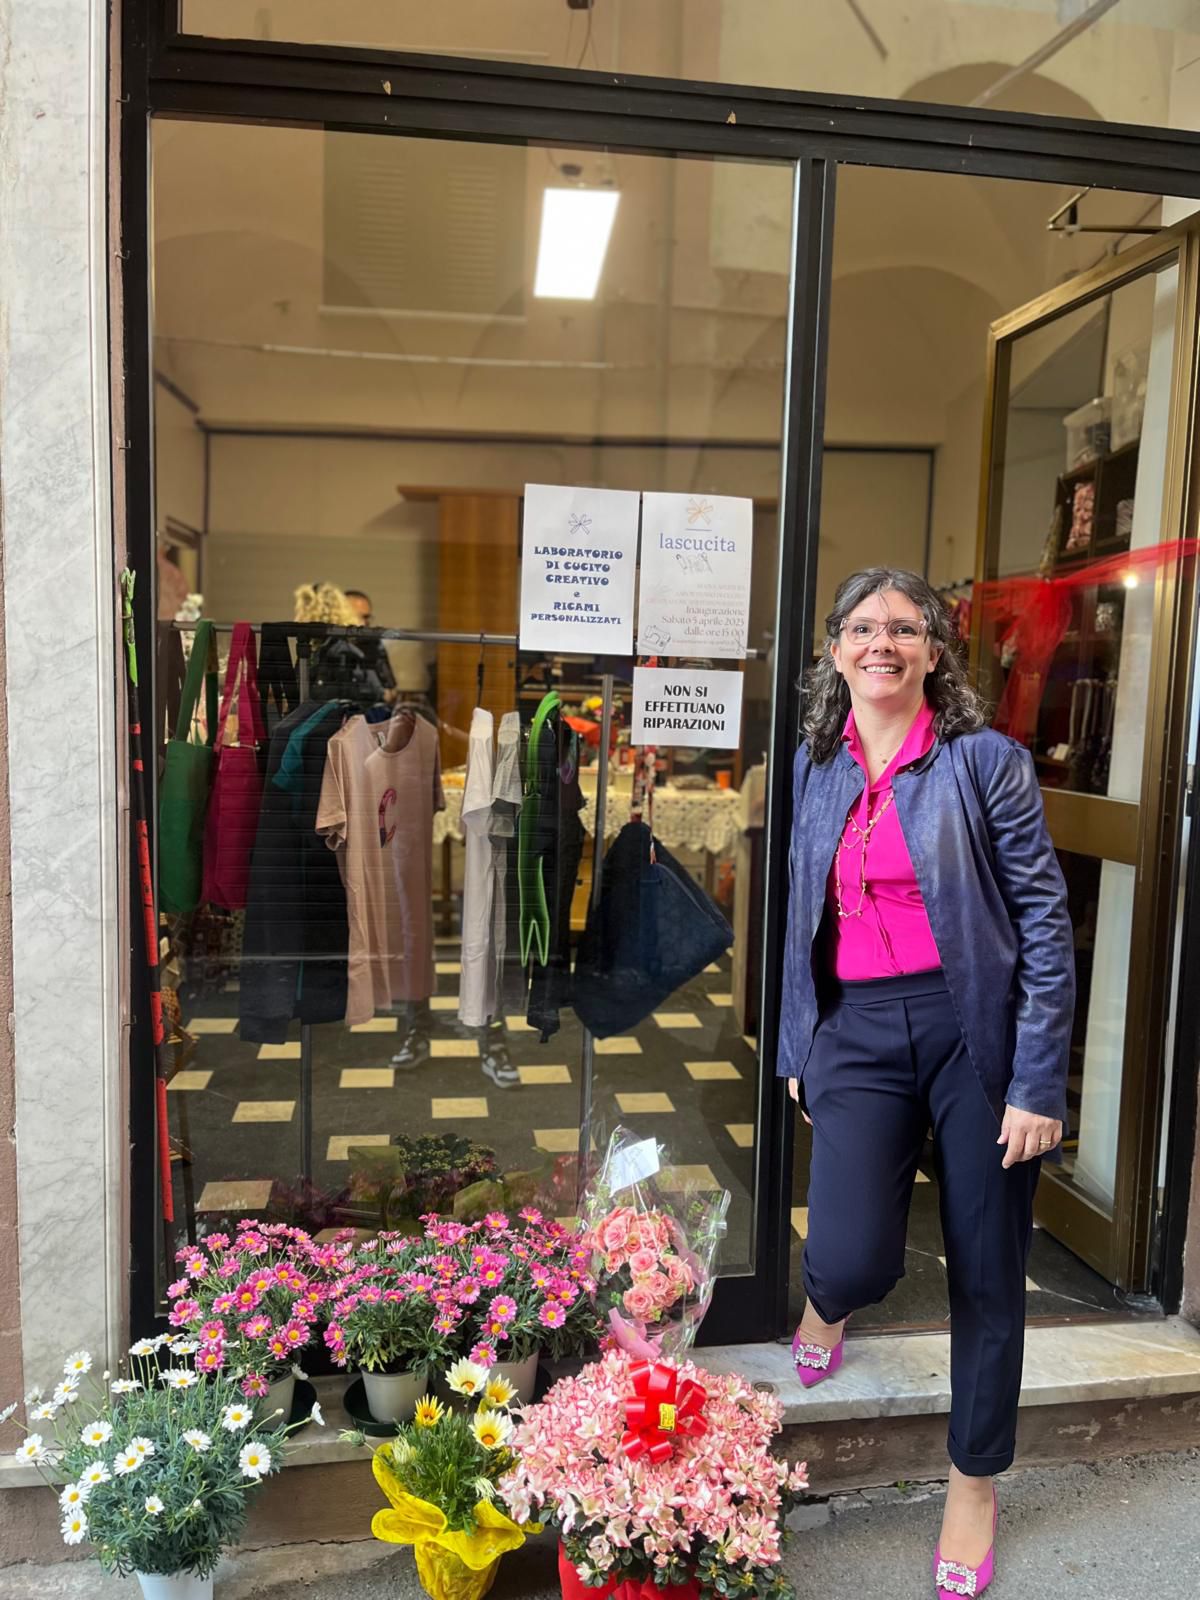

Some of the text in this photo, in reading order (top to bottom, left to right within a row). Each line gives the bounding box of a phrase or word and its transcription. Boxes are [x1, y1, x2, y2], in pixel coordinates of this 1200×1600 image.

[659, 532, 736, 553] lascucita
[534, 547, 623, 559] LABORATORIO
[545, 560, 610, 573] DI CUCITO
[545, 574, 609, 586] CREATIVO
[553, 601, 600, 612] RICAMI
[686, 606, 745, 617] Inaugurazione
[531, 613, 621, 624] PERSONALIZZATI
[662, 616, 691, 624] Sabato
[698, 617, 724, 627] aprile
[683, 626, 704, 636] dalle
[705, 629, 722, 637] ore
[663, 684, 708, 697] NON SI
[645, 701, 725, 714] EFFETTUANO
[643, 717, 725, 731] RIPARAZIONI
